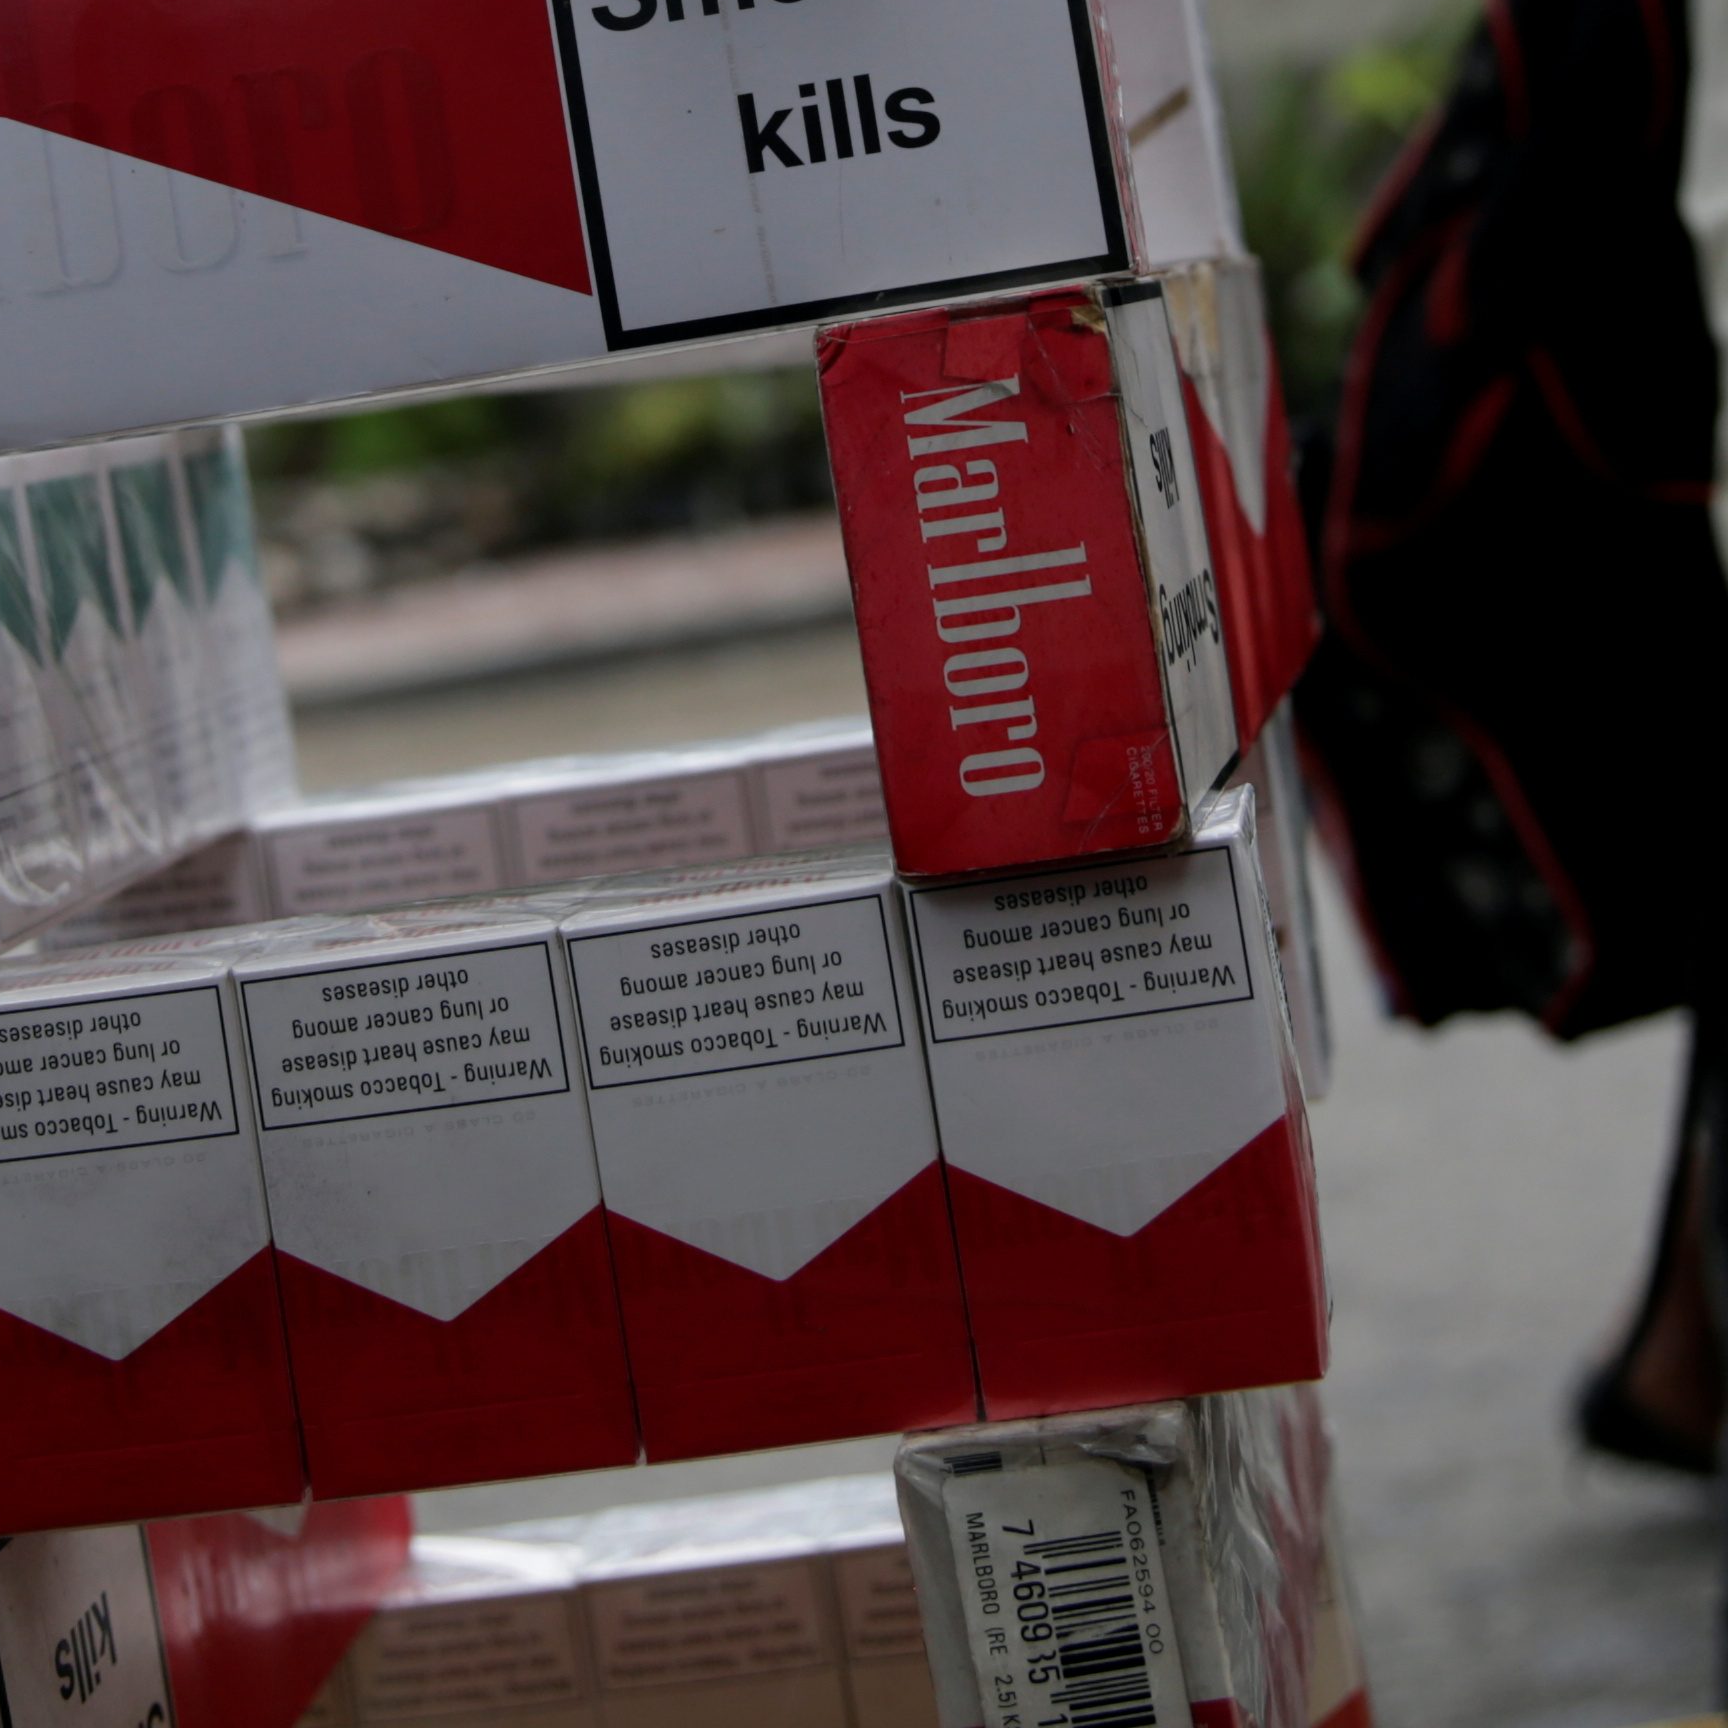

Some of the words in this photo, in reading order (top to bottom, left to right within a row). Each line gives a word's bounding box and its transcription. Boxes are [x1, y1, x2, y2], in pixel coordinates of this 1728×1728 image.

[737, 73, 941, 173] kills
[1149, 427, 1180, 509] kills
[899, 373, 1093, 799] Marlboro
[1158, 569, 1220, 673] Smoking
[1126, 747, 1149, 834] CIGARETTES
[993, 884, 1088, 913] diseases
[1092, 875, 1149, 900] other
[1117, 906, 1165, 929] lung
[1168, 902, 1191, 921] or
[746, 922, 801, 947] other
[962, 925, 1034, 950] among
[1039, 914, 1112, 940] cancer
[649, 931, 741, 960] diseases
[1099, 940, 1163, 965] cause
[1168, 932, 1213, 955] may
[770, 954, 817, 976] lung
[821, 950, 843, 969] or
[952, 958, 1033, 985] disease
[1036, 950, 1096, 977] heart
[415, 968, 470, 993] other
[619, 972, 689, 998] among
[694, 961, 766, 988] cancer
[1142, 964, 1237, 994] Warning
[321, 976, 411, 1003] diseases
[753, 987, 816, 1012] cause
[821, 980, 865, 1003] may
[1034, 980, 1126, 1008] Tobacco
[364, 1006, 434, 1031] cancer
[439, 999, 485, 1022] lung
[488, 996, 510, 1015] or
[691, 997, 750, 1023] heart
[941, 992, 1029, 1023] smoking
[89, 1011, 142, 1035] other
[291, 1015, 359, 1040] among
[609, 1006, 688, 1032] disease
[795, 1011, 888, 1041] Warning
[160, 1038, 181, 1057] or
[422, 1032, 483, 1056] cause
[488, 1025, 531, 1048] may
[689, 1027, 780, 1054] Tobacco
[39, 1048, 108, 1072] cancer
[112, 1041, 156, 1064] lung
[281, 1049, 358, 1074] disease
[361, 1041, 418, 1067] heart
[598, 1039, 685, 1069] smoking
[159, 1068, 202, 1090] may
[359, 1071, 447, 1097] Tobacco
[462, 1057, 553, 1086] Warning
[35, 1082, 91, 1108] heart
[95, 1074, 155, 1098] cause
[270, 1082, 355, 1111] smoking
[33, 1112, 120, 1137] Tobacco
[135, 1099, 223, 1128] Warning
[965, 1512, 1001, 1615] MARLBORO
[54, 1591, 118, 1705] kills
